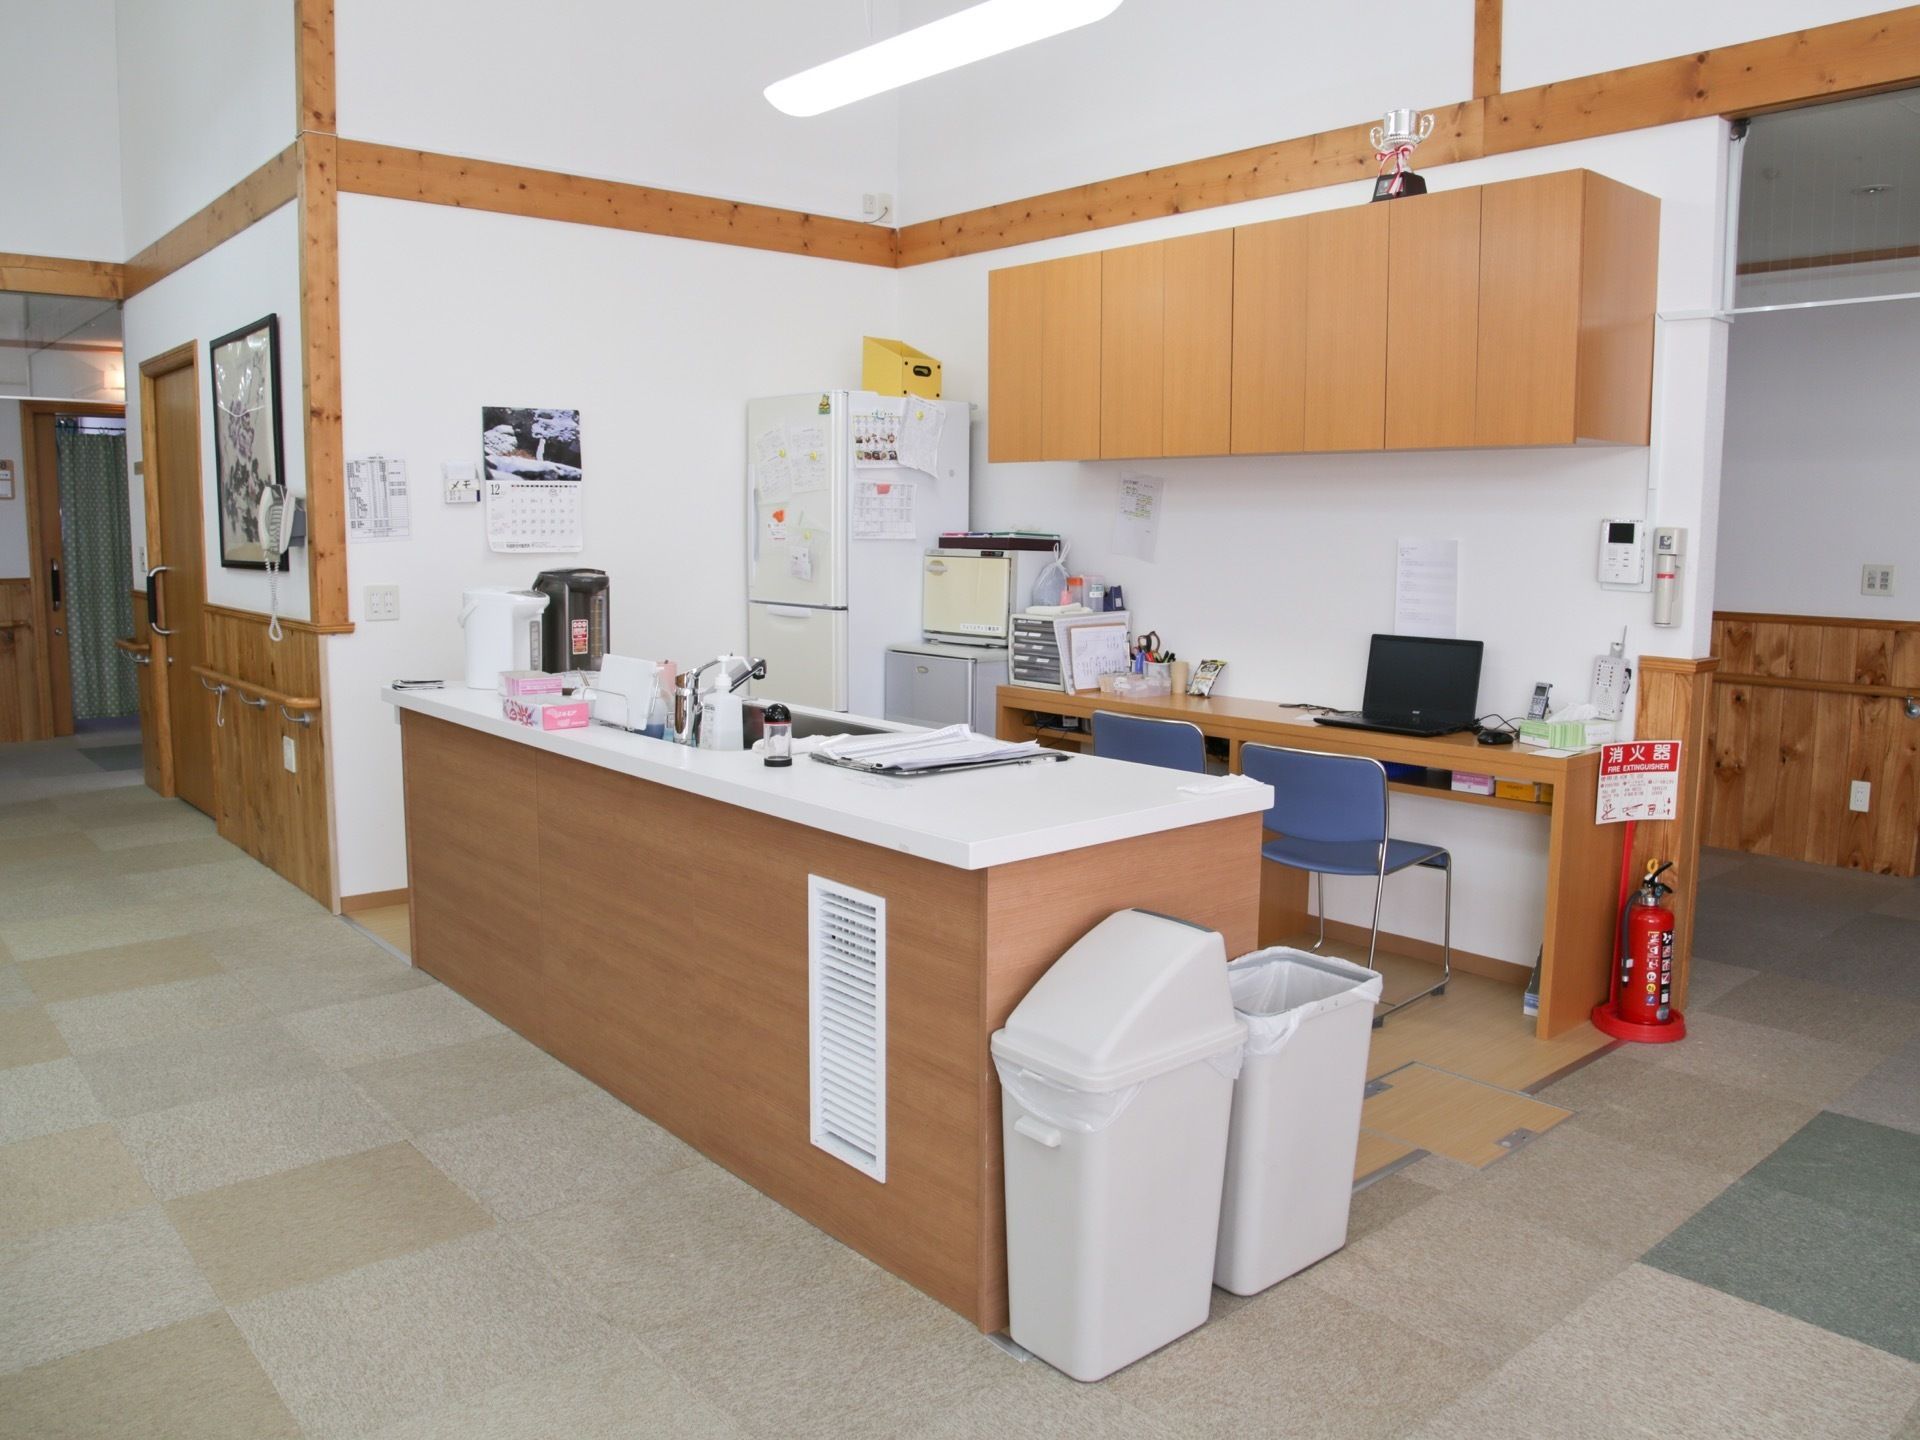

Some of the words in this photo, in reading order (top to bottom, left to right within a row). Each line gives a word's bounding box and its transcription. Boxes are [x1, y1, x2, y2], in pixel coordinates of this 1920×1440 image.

[451, 480, 471, 490] メモ
[490, 484, 500, 495] 12
[1608, 744, 1671, 763] 消火器
[1622, 763, 1669, 771] EXTINGUISHER
